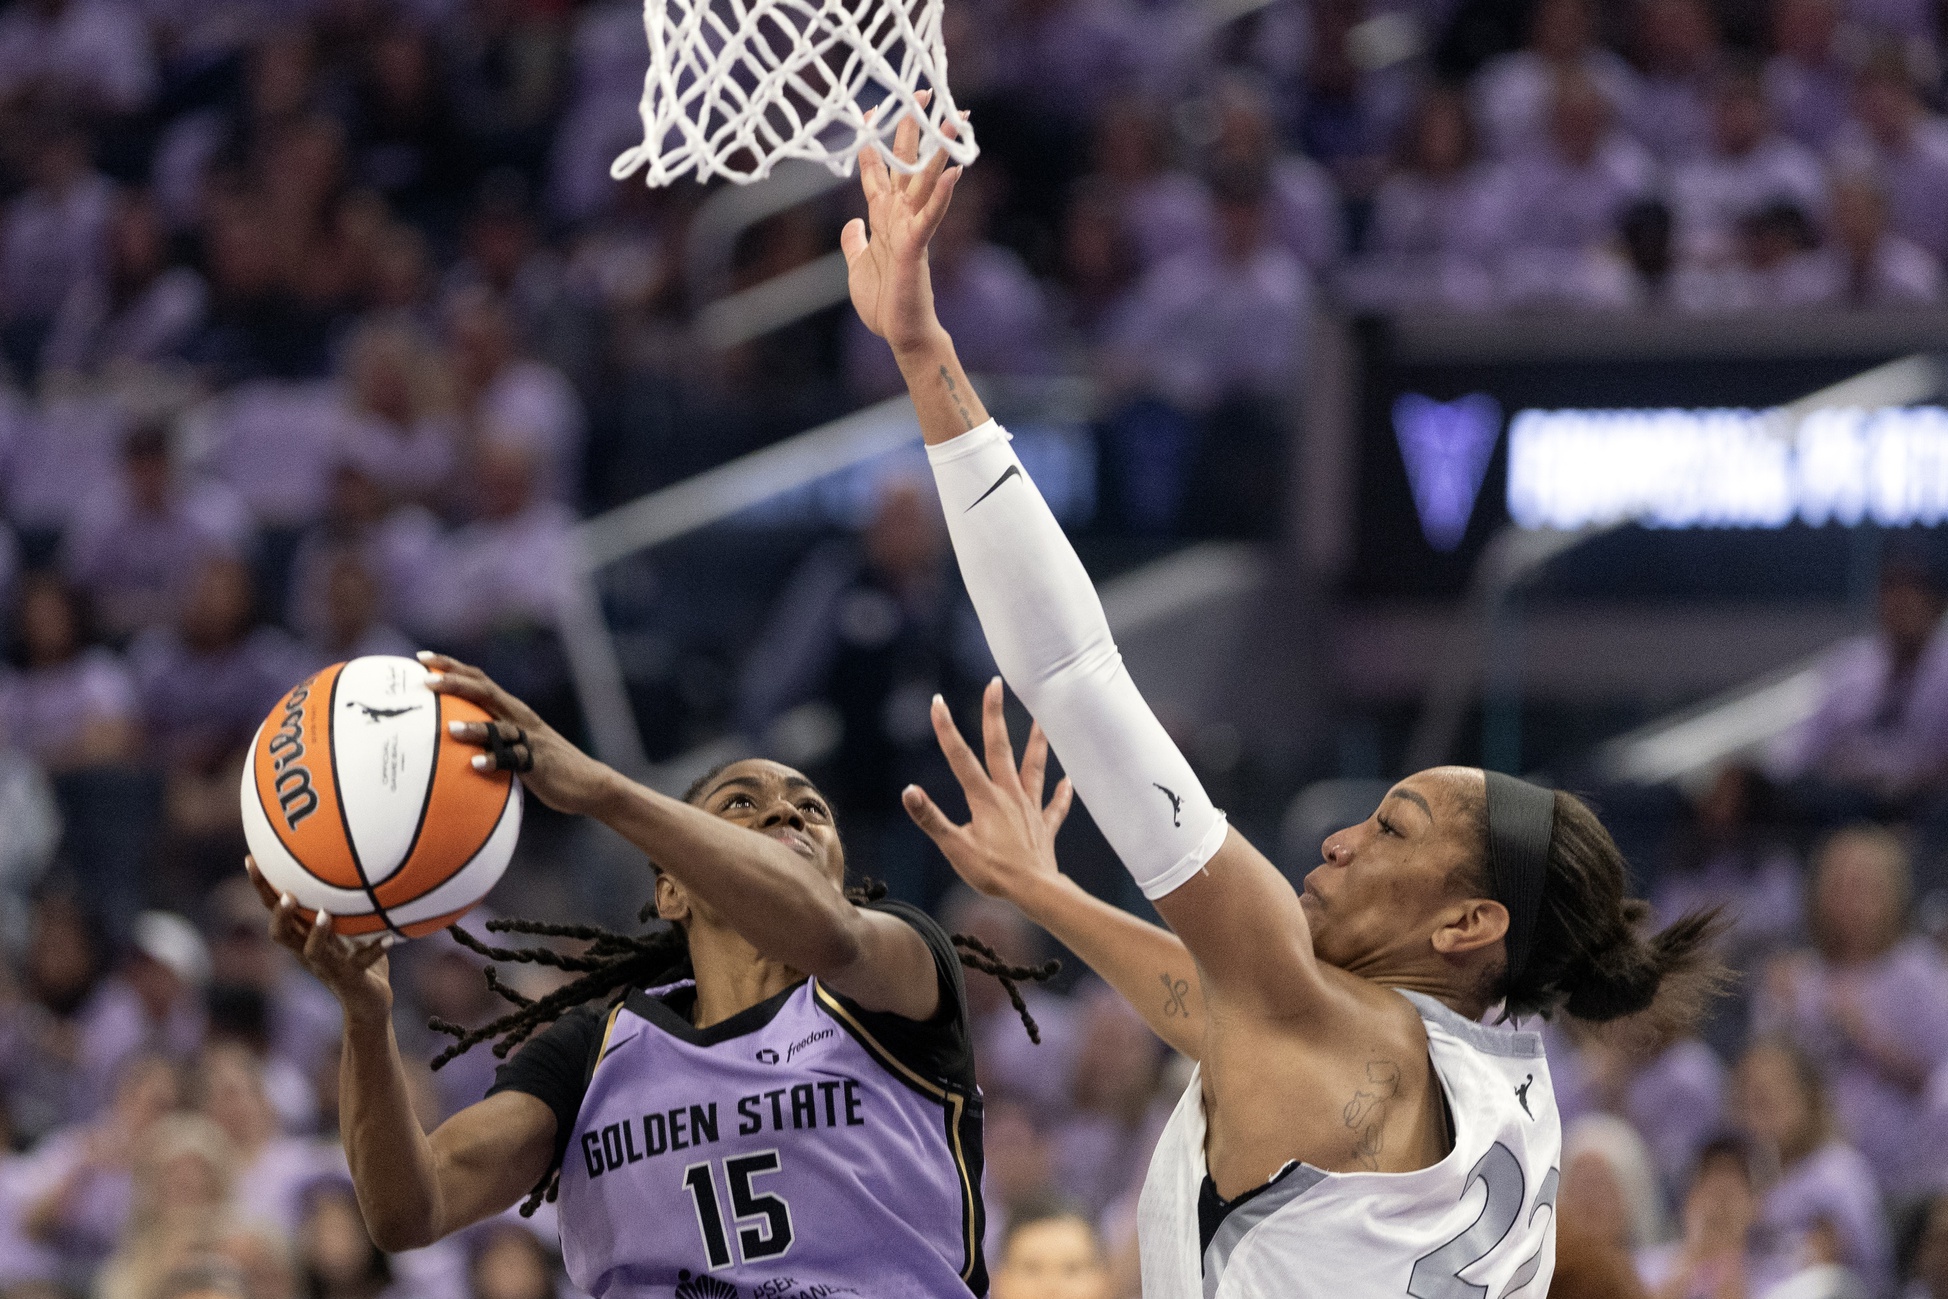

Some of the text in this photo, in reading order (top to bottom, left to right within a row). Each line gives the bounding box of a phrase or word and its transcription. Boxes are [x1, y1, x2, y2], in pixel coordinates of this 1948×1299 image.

[786, 1028, 834, 1063] freedom
[581, 1080, 865, 1180] GOLDEN STATE
[681, 1148, 796, 1273] 15
